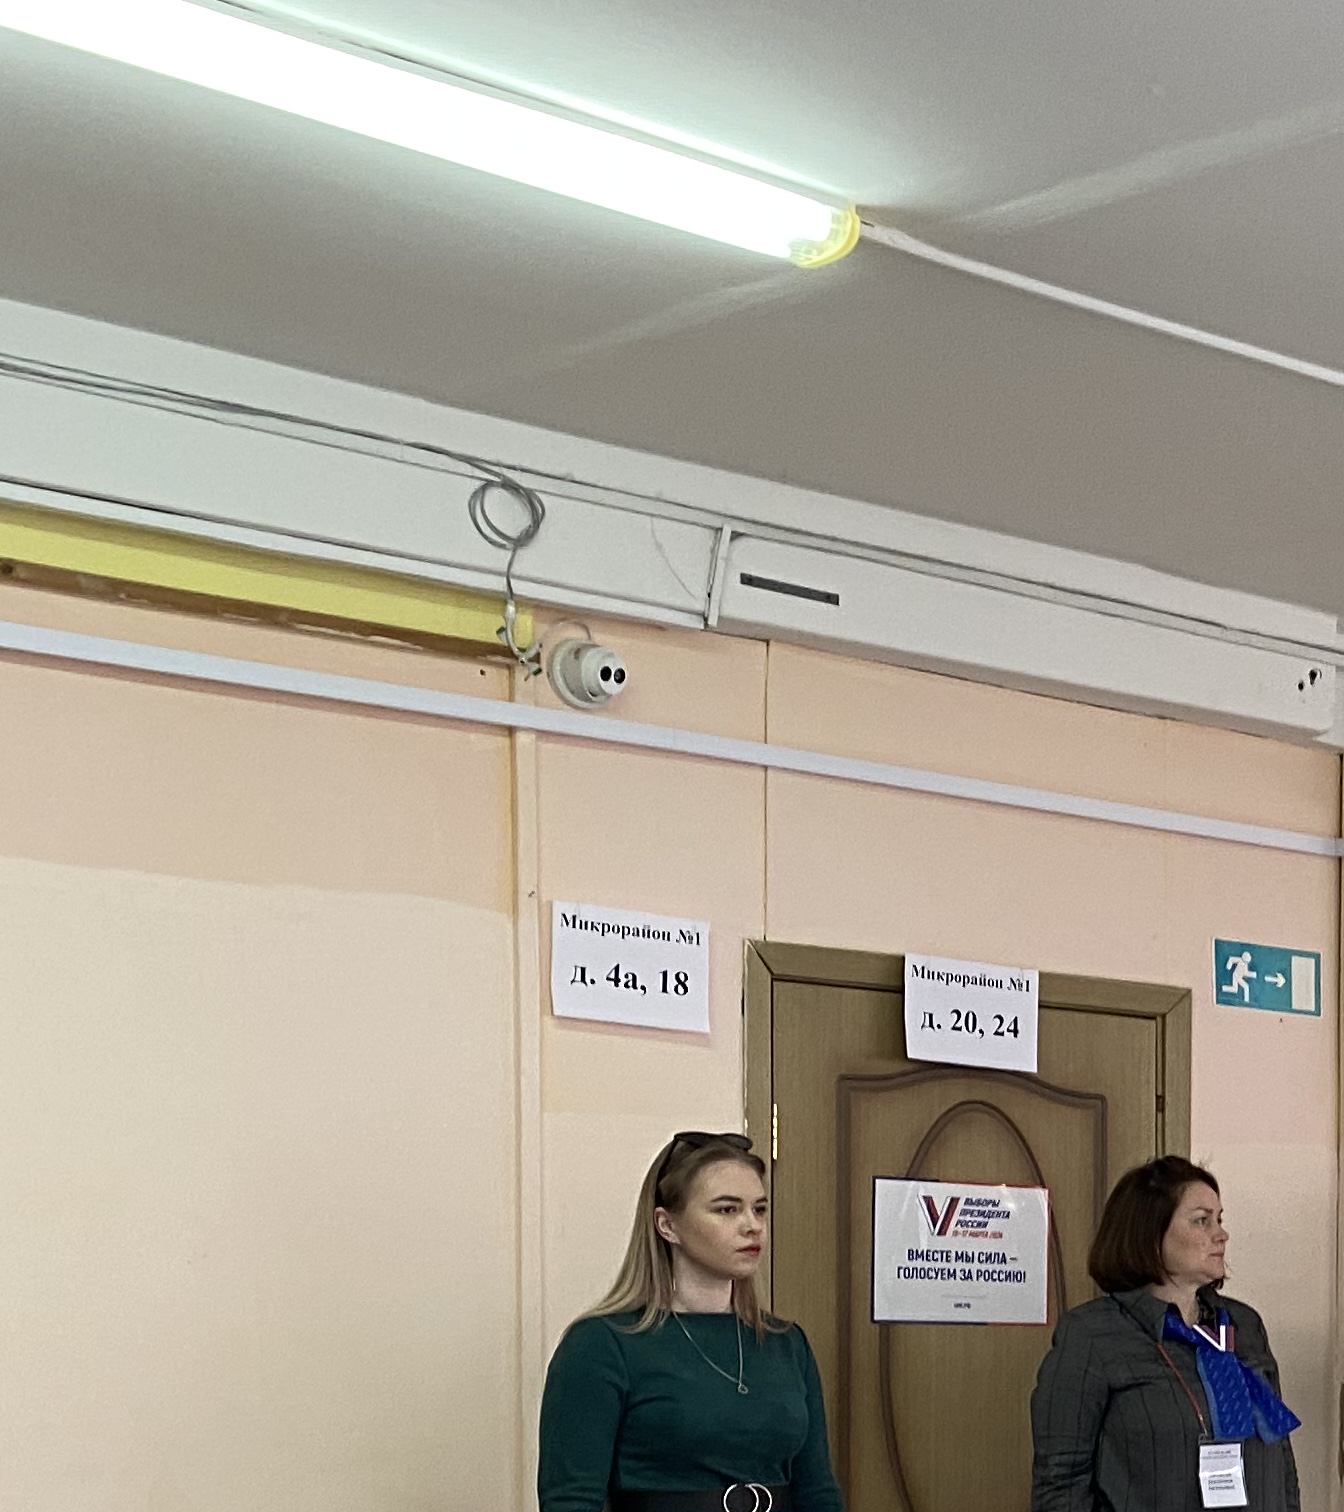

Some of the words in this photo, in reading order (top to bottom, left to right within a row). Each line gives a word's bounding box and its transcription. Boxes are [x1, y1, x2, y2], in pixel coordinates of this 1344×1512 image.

[561, 912, 671, 942] Микрорайон
[675, 929, 700, 946] №1
[570, 965, 596, 987] д.
[605, 963, 647, 996] 4а,
[659, 969, 689, 996] 18
[911, 964, 1003, 989] Микрорайон
[1006, 977, 1030, 992] №1
[920, 1011, 942, 1031] д.
[950, 1008, 985, 1039] 20,
[992, 1013, 1019, 1038] 24
[907, 1249, 951, 1263] ВМЕСТЕ
[955, 1250, 975, 1264] МЫ
[977, 1251, 1007, 1265] СИЛА
[897, 1266, 957, 1281] ГОЛОСУЕМ
[959, 1268, 973, 1282] ЗА
[976, 1269, 1026, 1283] РОССИЮ!
